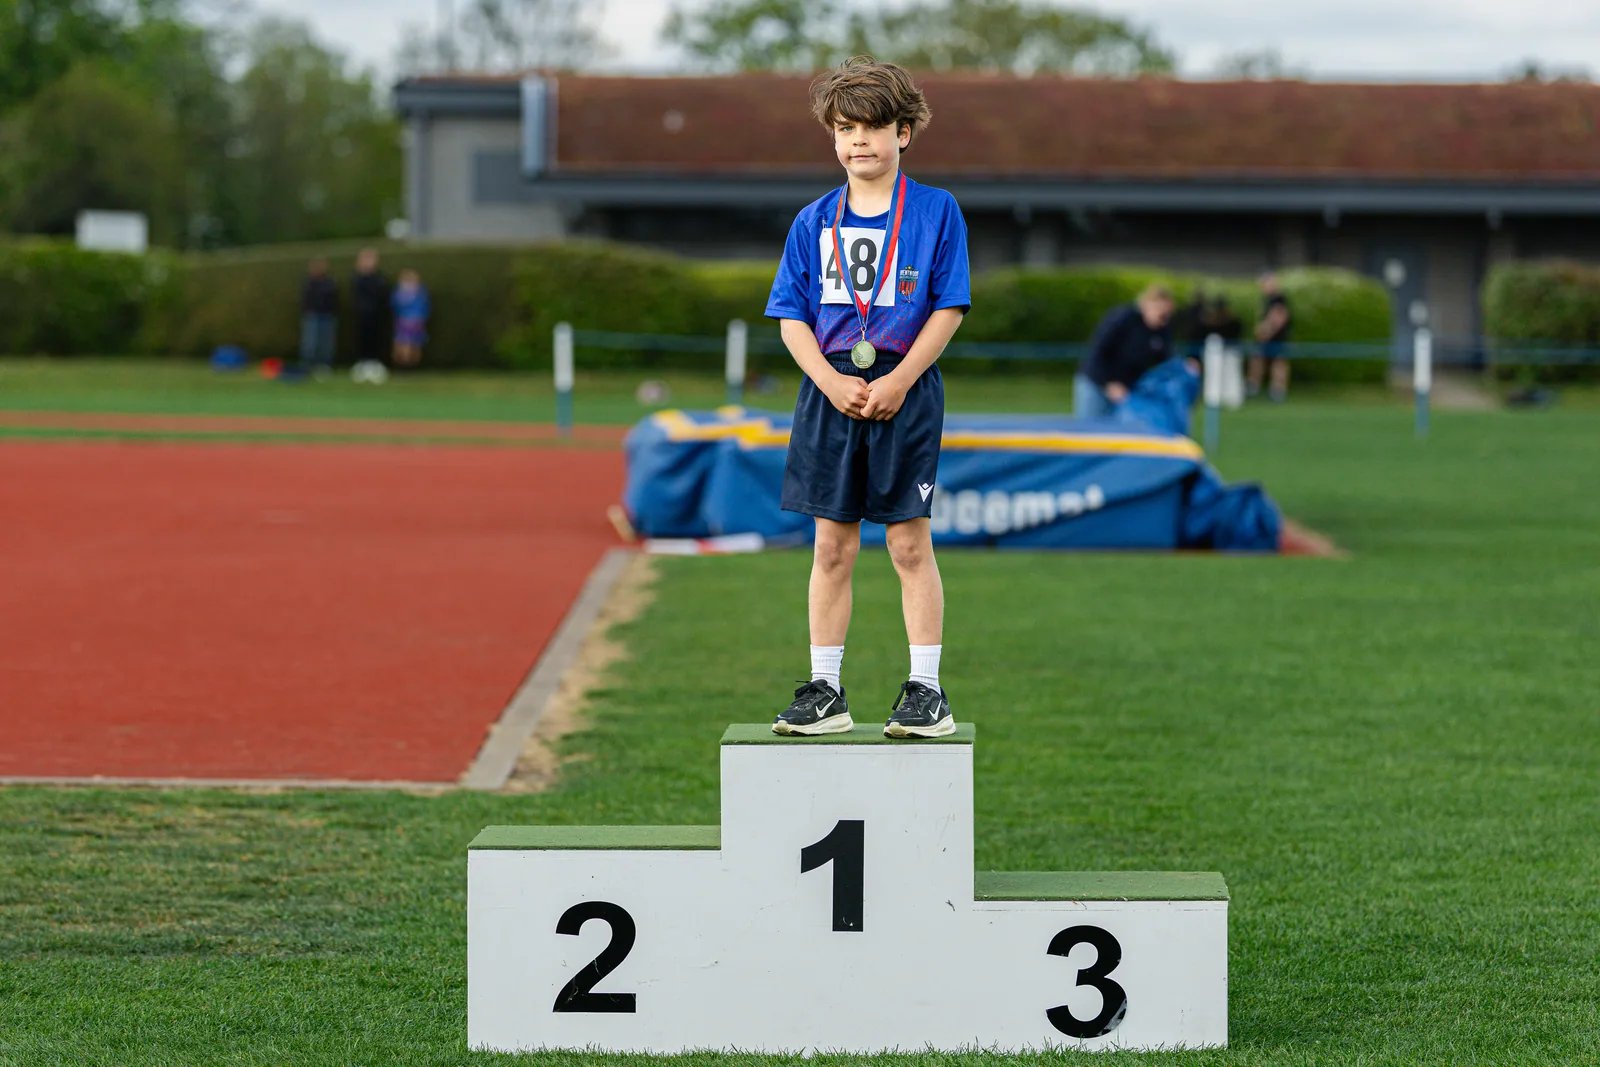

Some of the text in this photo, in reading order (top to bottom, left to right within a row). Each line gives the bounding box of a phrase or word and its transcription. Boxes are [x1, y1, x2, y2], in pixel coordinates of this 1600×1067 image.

[826, 238, 877, 292] 48
[801, 820, 864, 932] 1
[553, 901, 636, 1013] 2
[1046, 925, 1127, 1038] 3
